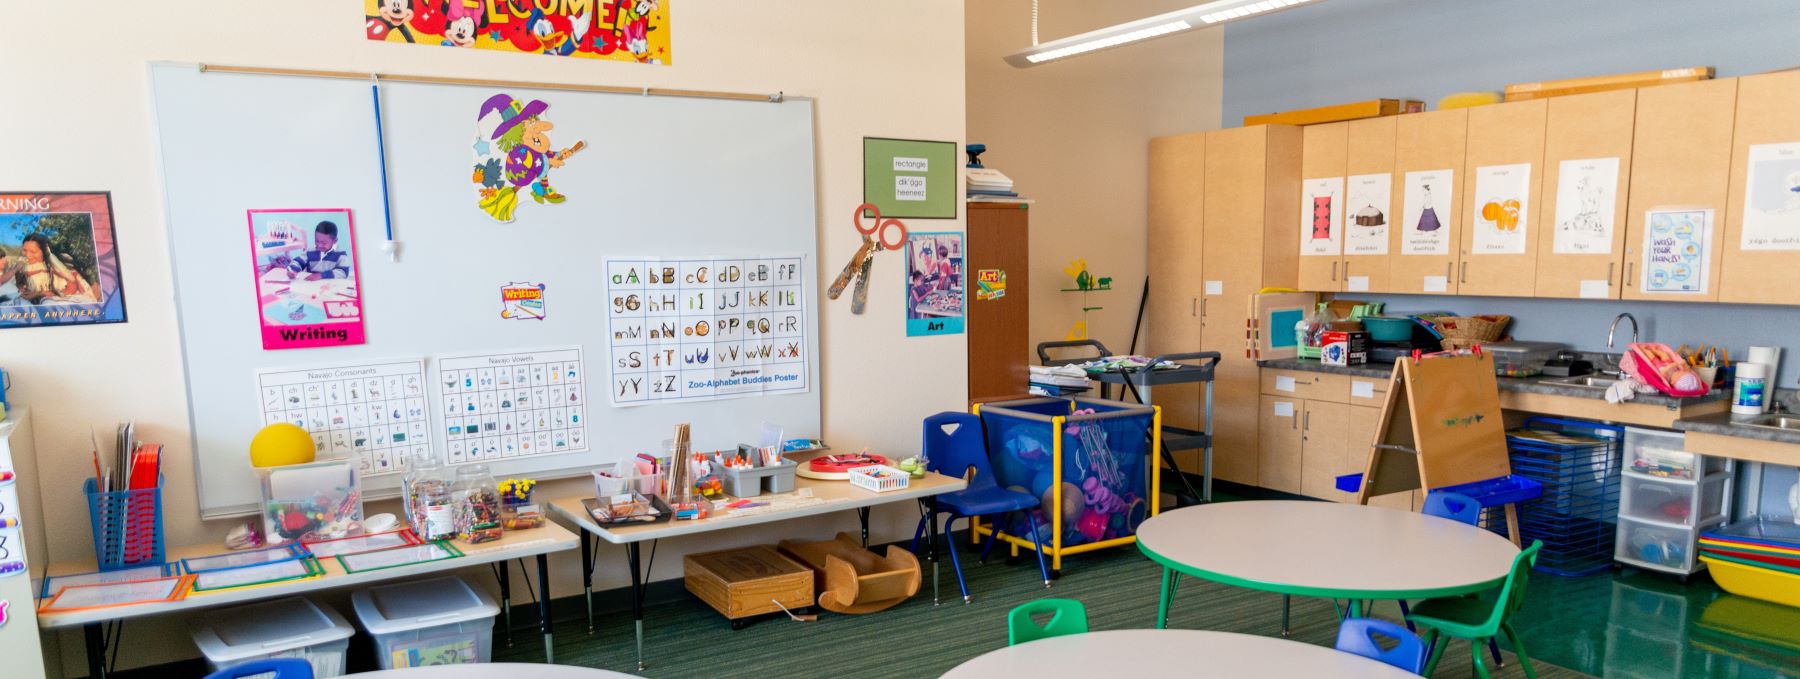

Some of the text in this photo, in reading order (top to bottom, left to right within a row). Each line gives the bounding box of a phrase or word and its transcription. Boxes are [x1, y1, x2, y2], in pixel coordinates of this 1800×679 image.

[896, 161, 927, 169] rectangle
[897, 189, 925, 197] heeneez
[980, 271, 998, 281] Art
[505, 288, 541, 299] Writing
[927, 321, 944, 331] Art
[280, 326, 348, 342] Writing
[308, 368, 377, 379] Navajo Consonants
[688, 377, 740, 389] Zoo-Alphabet
[742, 375, 772, 385] Buddies
[774, 374, 798, 382] Poster
